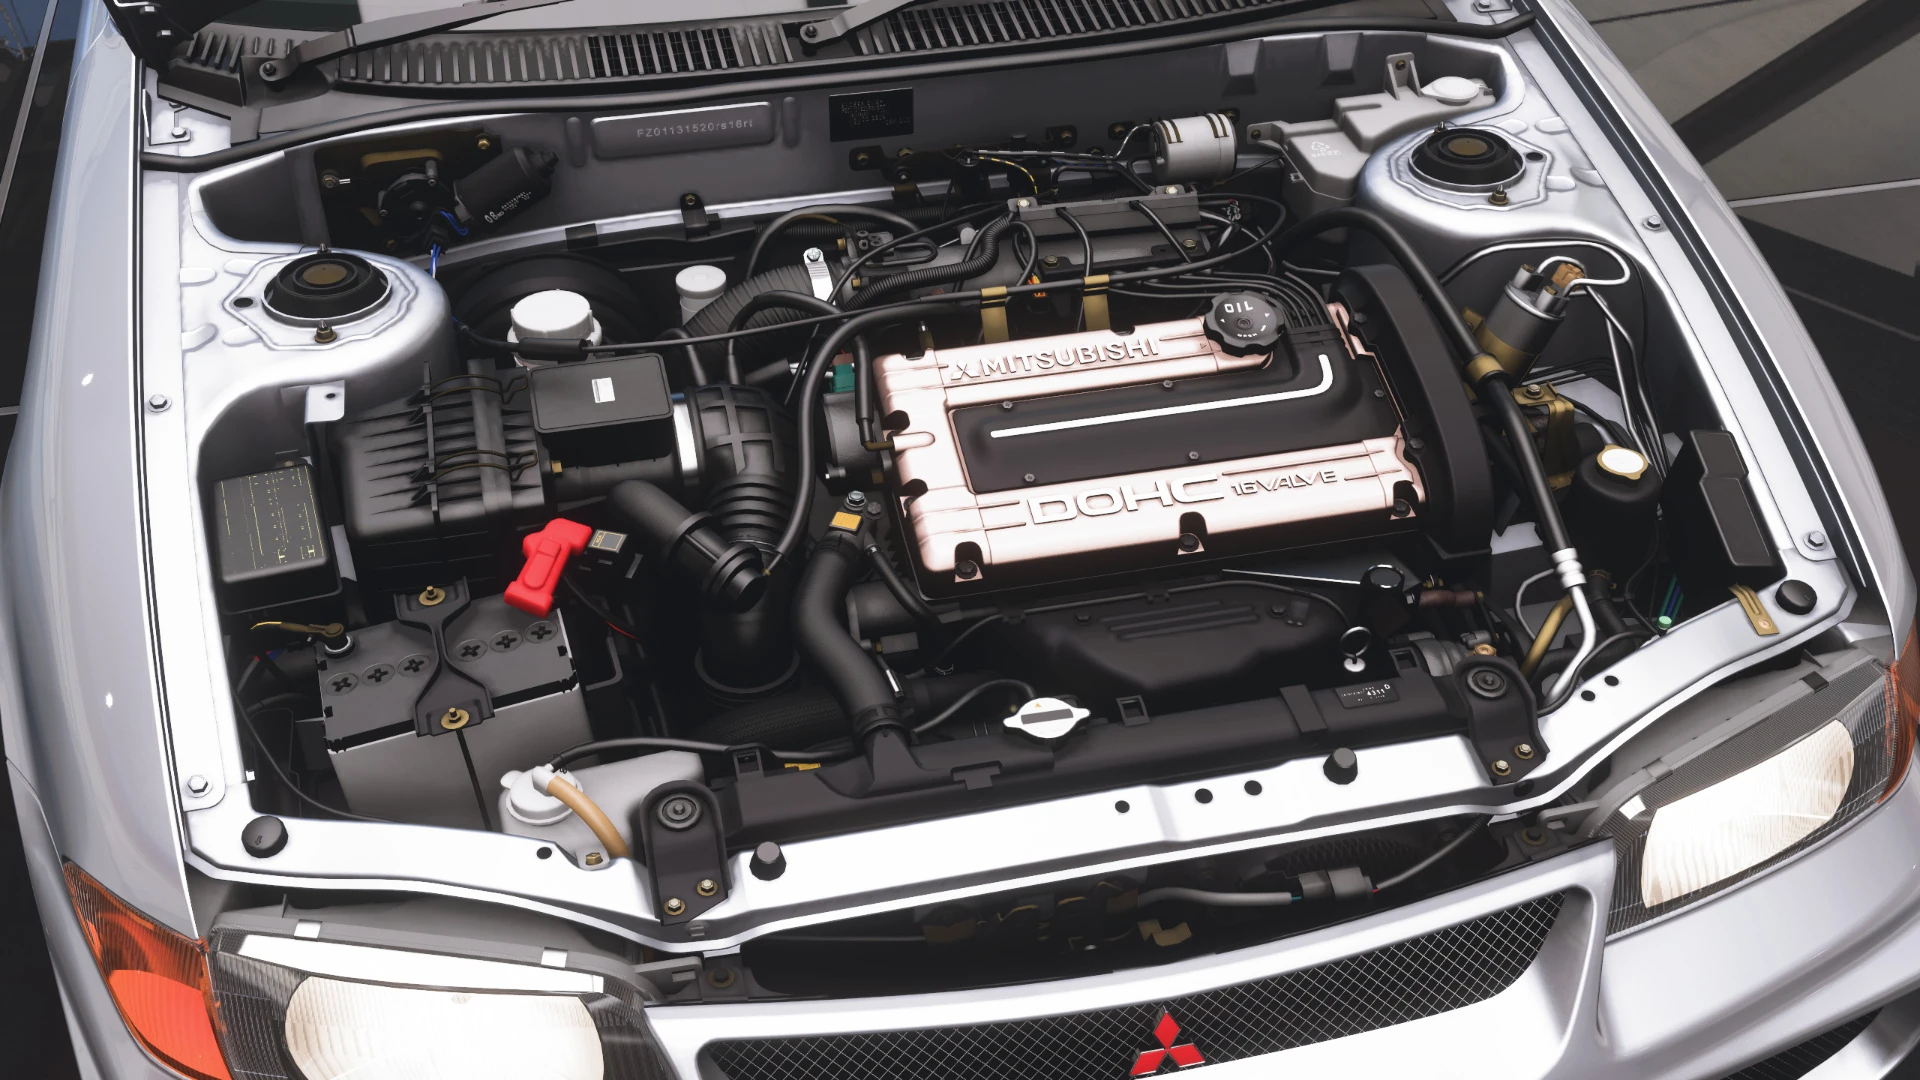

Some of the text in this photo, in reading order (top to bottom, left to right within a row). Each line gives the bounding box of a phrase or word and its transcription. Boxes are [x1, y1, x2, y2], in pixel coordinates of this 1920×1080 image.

[1224, 301, 1254, 313] OIL
[979, 337, 1160, 377] MITSUBISHI
[1027, 473, 1225, 525] DOHC
